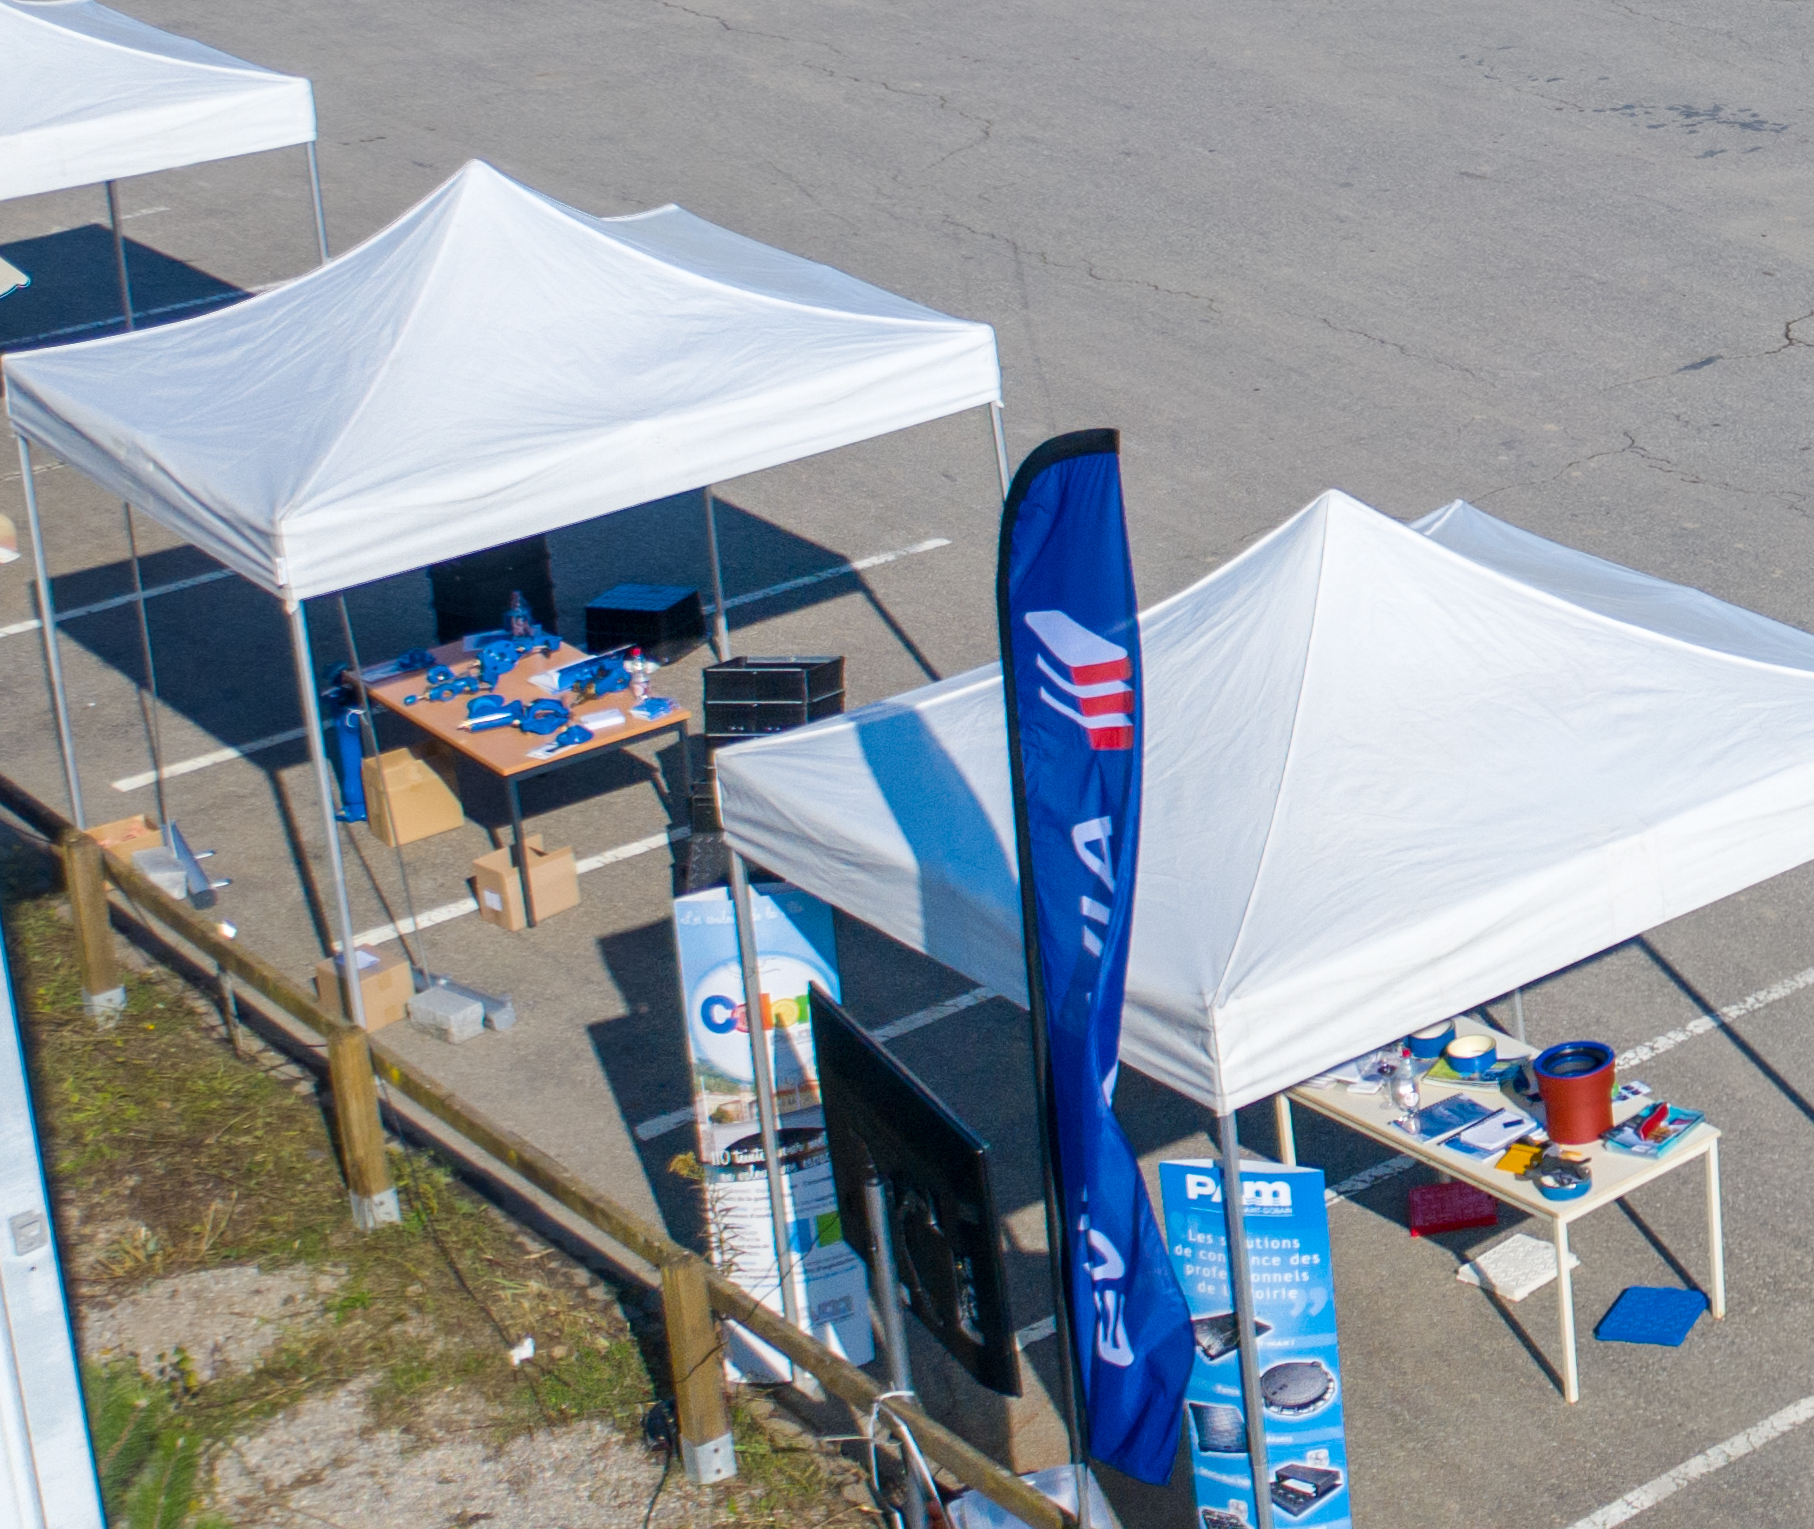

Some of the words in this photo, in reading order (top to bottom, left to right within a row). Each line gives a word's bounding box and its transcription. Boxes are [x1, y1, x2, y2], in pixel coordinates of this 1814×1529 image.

[1188, 1228, 1213, 1245] Les
[1220, 1234, 1300, 1250] sutions
[1174, 1243, 1192, 1257] de
[1200, 1250, 1281, 1267] connce
[1290, 1252, 1321, 1266] des
[1185, 1264, 1310, 1283] profeonnels
[1197, 1280, 1216, 1294] de
[1255, 1286, 1299, 1300] oirie
